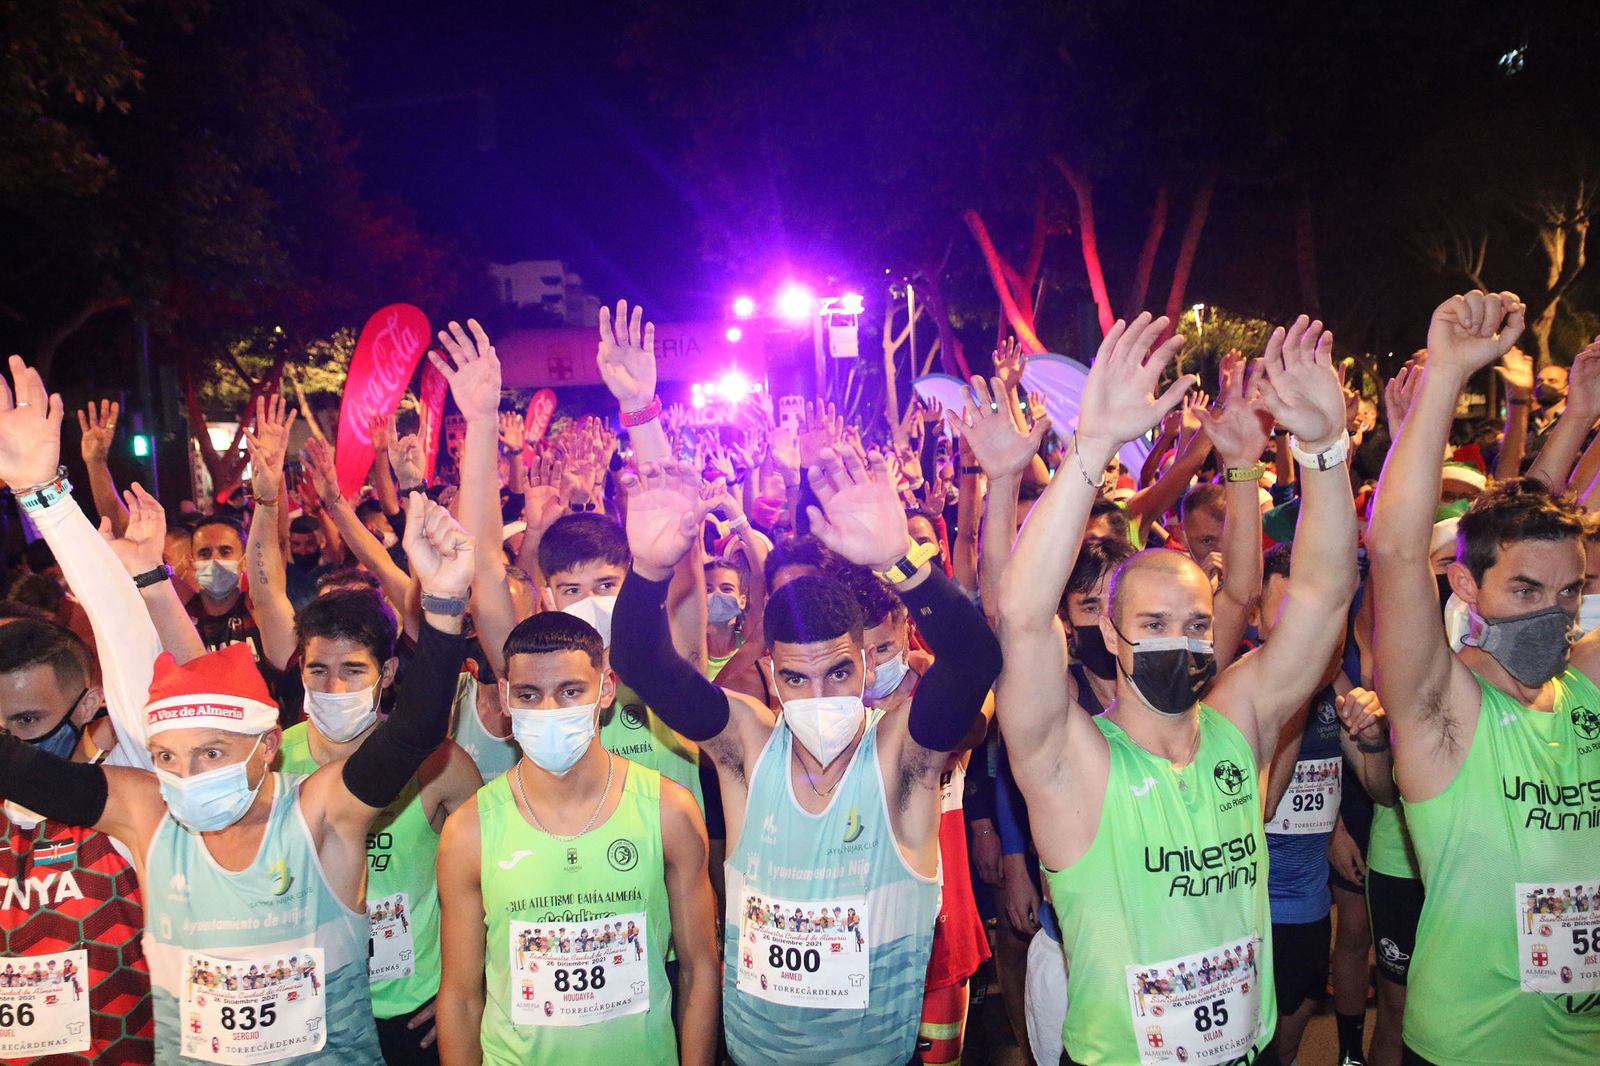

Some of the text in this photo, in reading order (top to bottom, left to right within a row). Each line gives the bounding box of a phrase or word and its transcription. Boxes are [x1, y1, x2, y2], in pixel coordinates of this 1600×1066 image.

[158, 709, 178, 719] Voz
[179, 707, 195, 717] de
[1293, 793, 1324, 812] 929
[1145, 832, 1257, 873] Universo
[1169, 861, 1257, 898] Running
[528, 894, 575, 909] ATLETISMO
[577, 890, 604, 905] BAHÍA
[605, 887, 642, 901] ALMERÍA
[184, 908, 260, 934] Ayuntamiento
[263, 912, 279, 928] de
[773, 937, 802, 946] Diciembre
[769, 944, 821, 972] 800
[554, 965, 606, 992] 838
[781, 971, 802, 981] AHMED
[262, 994, 279, 1002] 2021
[563, 992, 595, 1002] HOUDAYFA
[1185, 993, 1216, 1005] Diciembre
[1219, 987, 1233, 996] 2021
[0, 1002, 36, 1028] 66
[221, 1002, 277, 1031] 835
[1194, 998, 1228, 1032] 85
[1203, 1029, 1223, 1042] KILIAN
